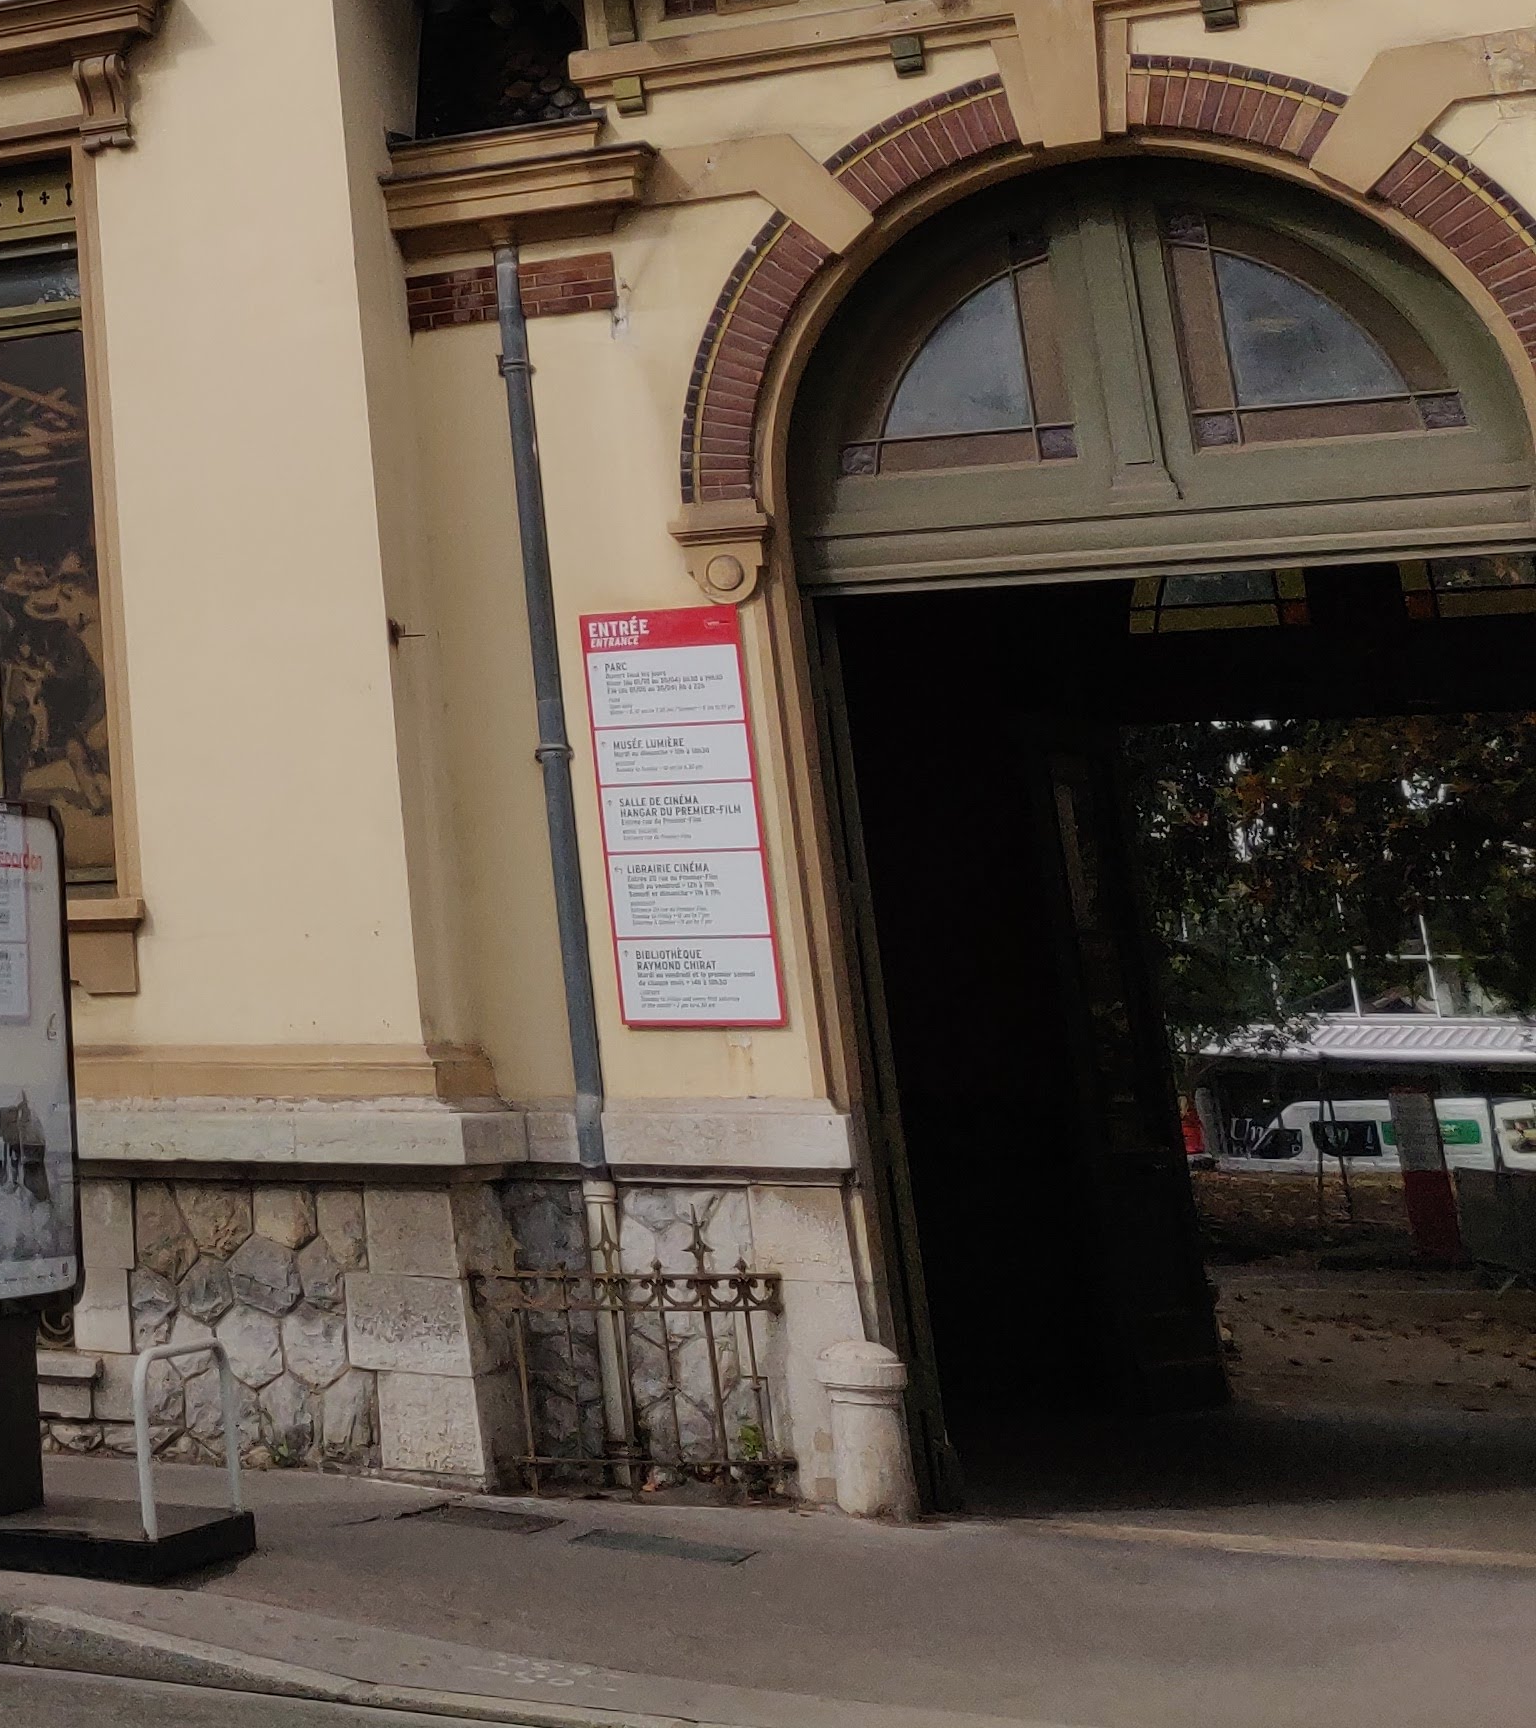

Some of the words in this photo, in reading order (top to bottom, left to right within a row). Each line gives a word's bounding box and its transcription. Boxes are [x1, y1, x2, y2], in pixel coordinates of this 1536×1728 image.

[588, 616, 650, 637] ENTRÉE
[590, 635, 639, 648] ENTRANCE
[604, 663, 628, 672] PARC
[613, 738, 642, 750] MUSÉE
[646, 736, 684, 748] LUMIÈRE
[619, 797, 646, 807] SALLE
[650, 797, 661, 806] DE
[664, 794, 699, 805] CINÉMA
[620, 807, 657, 818] HANGAR
[660, 806, 673, 816] DU
[675, 803, 741, 816] PREMIER-FILM
[627, 864, 671, 874] LIBRAIRIE
[674, 861, 709, 873] CINÉMA
[635, 947, 702, 960] BIBLIOTHÈQUE
[637, 961, 681, 971] RAYMOND
[683, 960, 717, 970] CHIRAT
